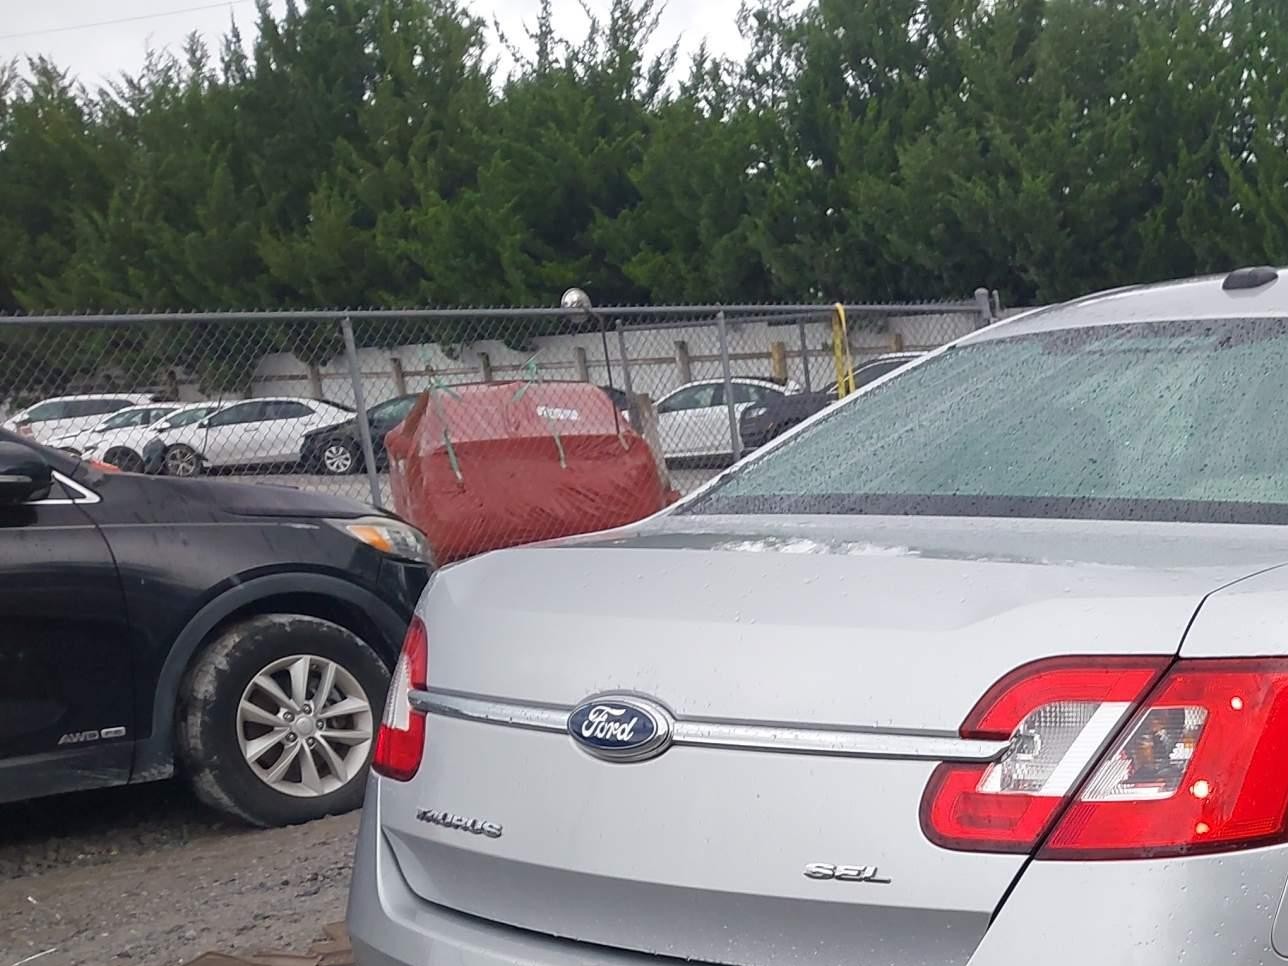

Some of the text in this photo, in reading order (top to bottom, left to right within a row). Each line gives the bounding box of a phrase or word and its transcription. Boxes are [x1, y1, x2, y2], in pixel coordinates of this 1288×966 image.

[582, 705, 638, 741] Ford
[416, 808, 503, 838] TAURUS
[803, 863, 891, 884] SEL
